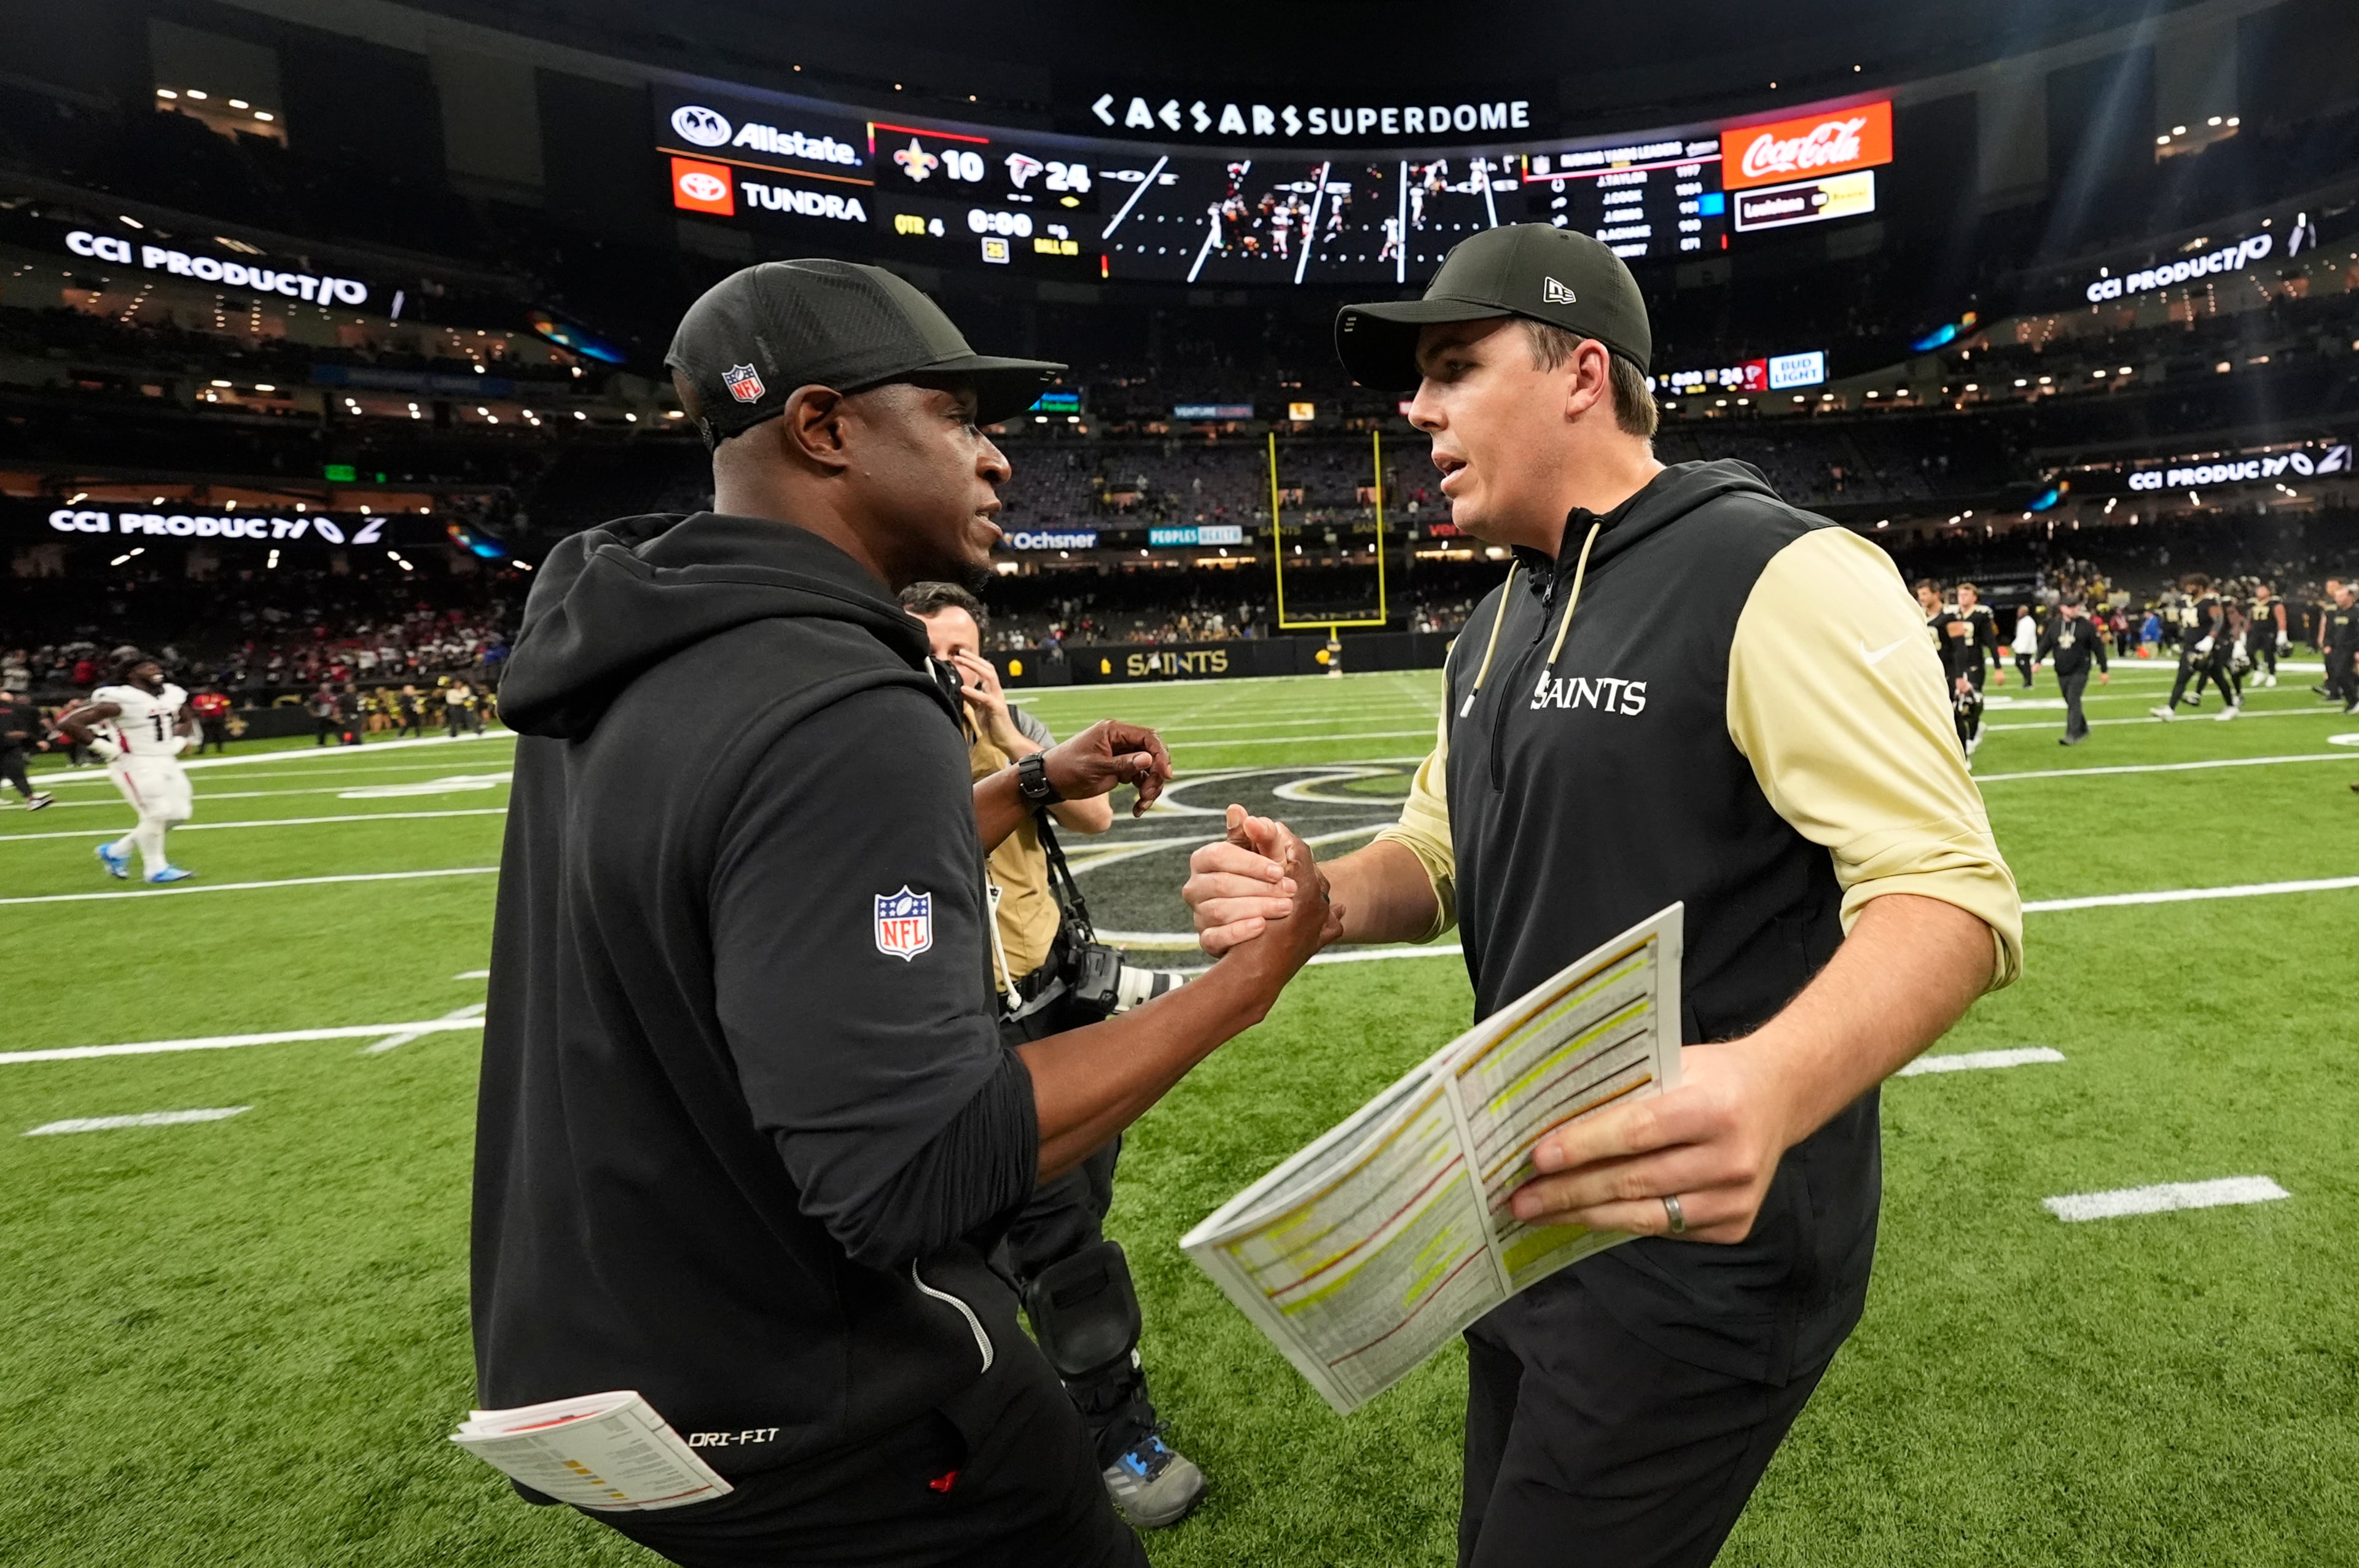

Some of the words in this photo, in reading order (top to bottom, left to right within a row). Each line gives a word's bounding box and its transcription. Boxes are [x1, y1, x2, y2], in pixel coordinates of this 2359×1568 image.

[1091, 93, 1303, 137] CAESARS
[1308, 101, 1530, 135] SUPERDOME
[941, 149, 984, 182] 10
[1045, 162, 1091, 192] 24
[741, 182, 867, 222] TUNDRA
[894, 214, 925, 235] QTR
[928, 218, 945, 237] 4
[968, 209, 1032, 237] 0:00
[65, 231, 132, 263] CCI
[2087, 278, 2122, 302] CCI
[1775, 369, 1818, 383] LIGHT
[1781, 359, 1812, 370] BUD
[733, 379, 761, 399] NFL
[2129, 470, 2163, 491] CCI
[49, 510, 111, 532] CCI
[1014, 532, 1097, 550] Ochsner
[1151, 531, 1197, 545] PEOPLES
[883, 919, 925, 949] NFL
[689, 1427, 780, 1447] DRI-FIT
